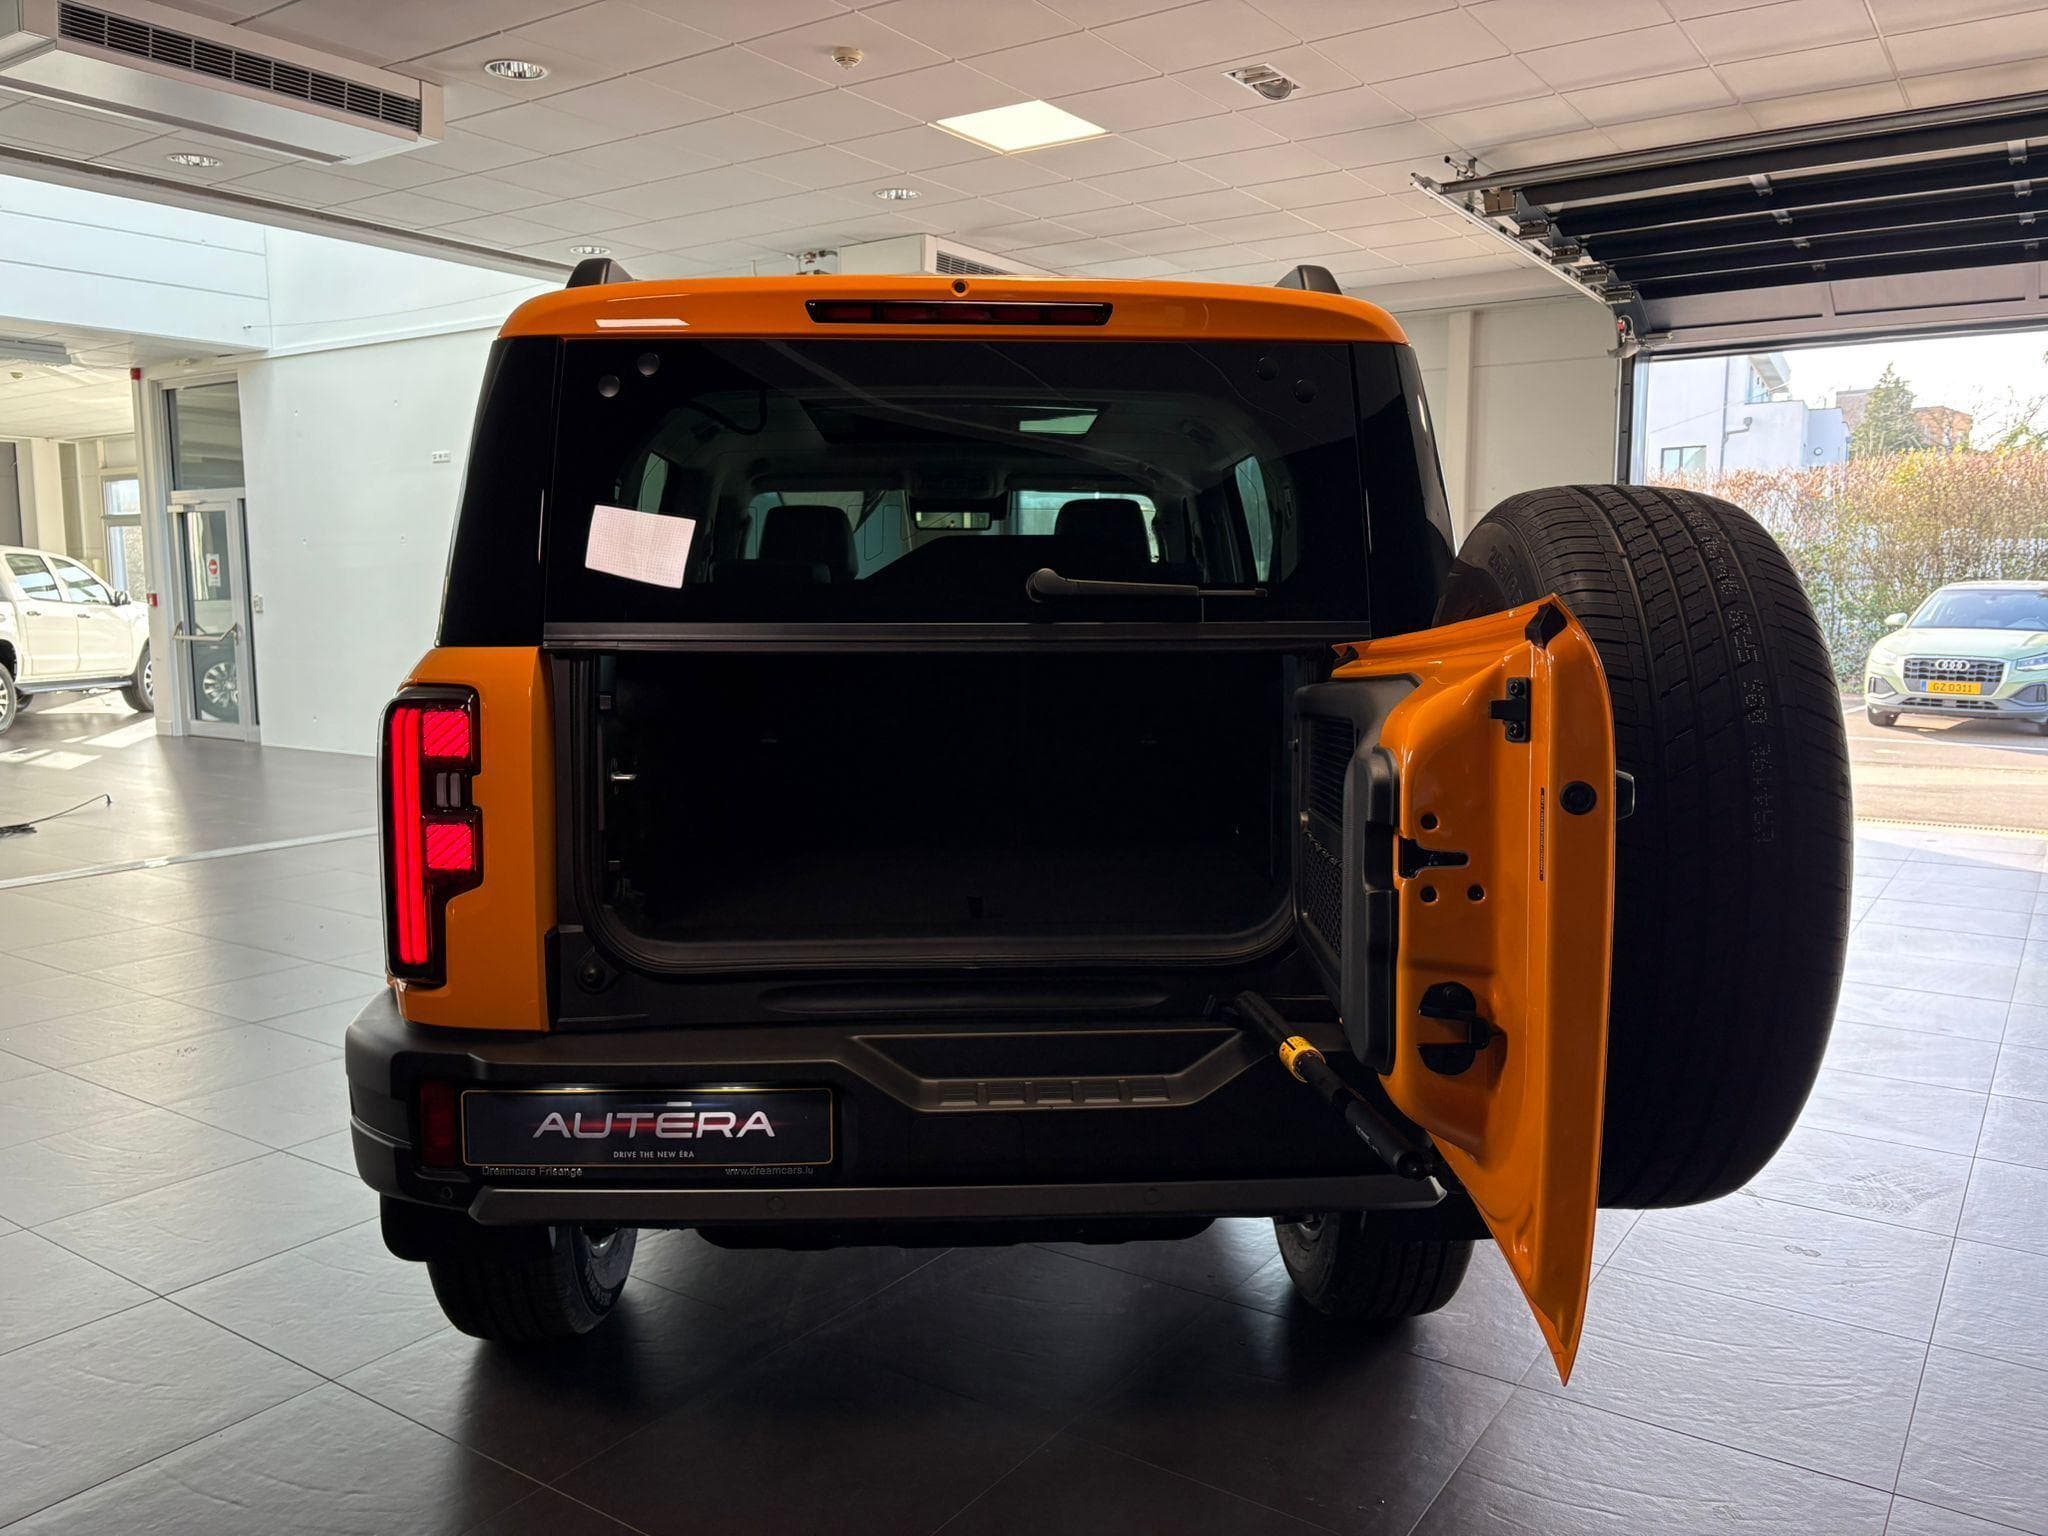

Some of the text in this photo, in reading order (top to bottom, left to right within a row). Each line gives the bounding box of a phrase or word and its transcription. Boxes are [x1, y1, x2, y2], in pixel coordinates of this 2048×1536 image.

[1933, 682, 1946, 692] GZ
[613, 1150, 637, 1159] DRIVE
[640, 1150, 654, 1159] THE
[657, 1150, 676, 1159] NEW
[725, 1165, 814, 1176] www.dreamcars.lu
